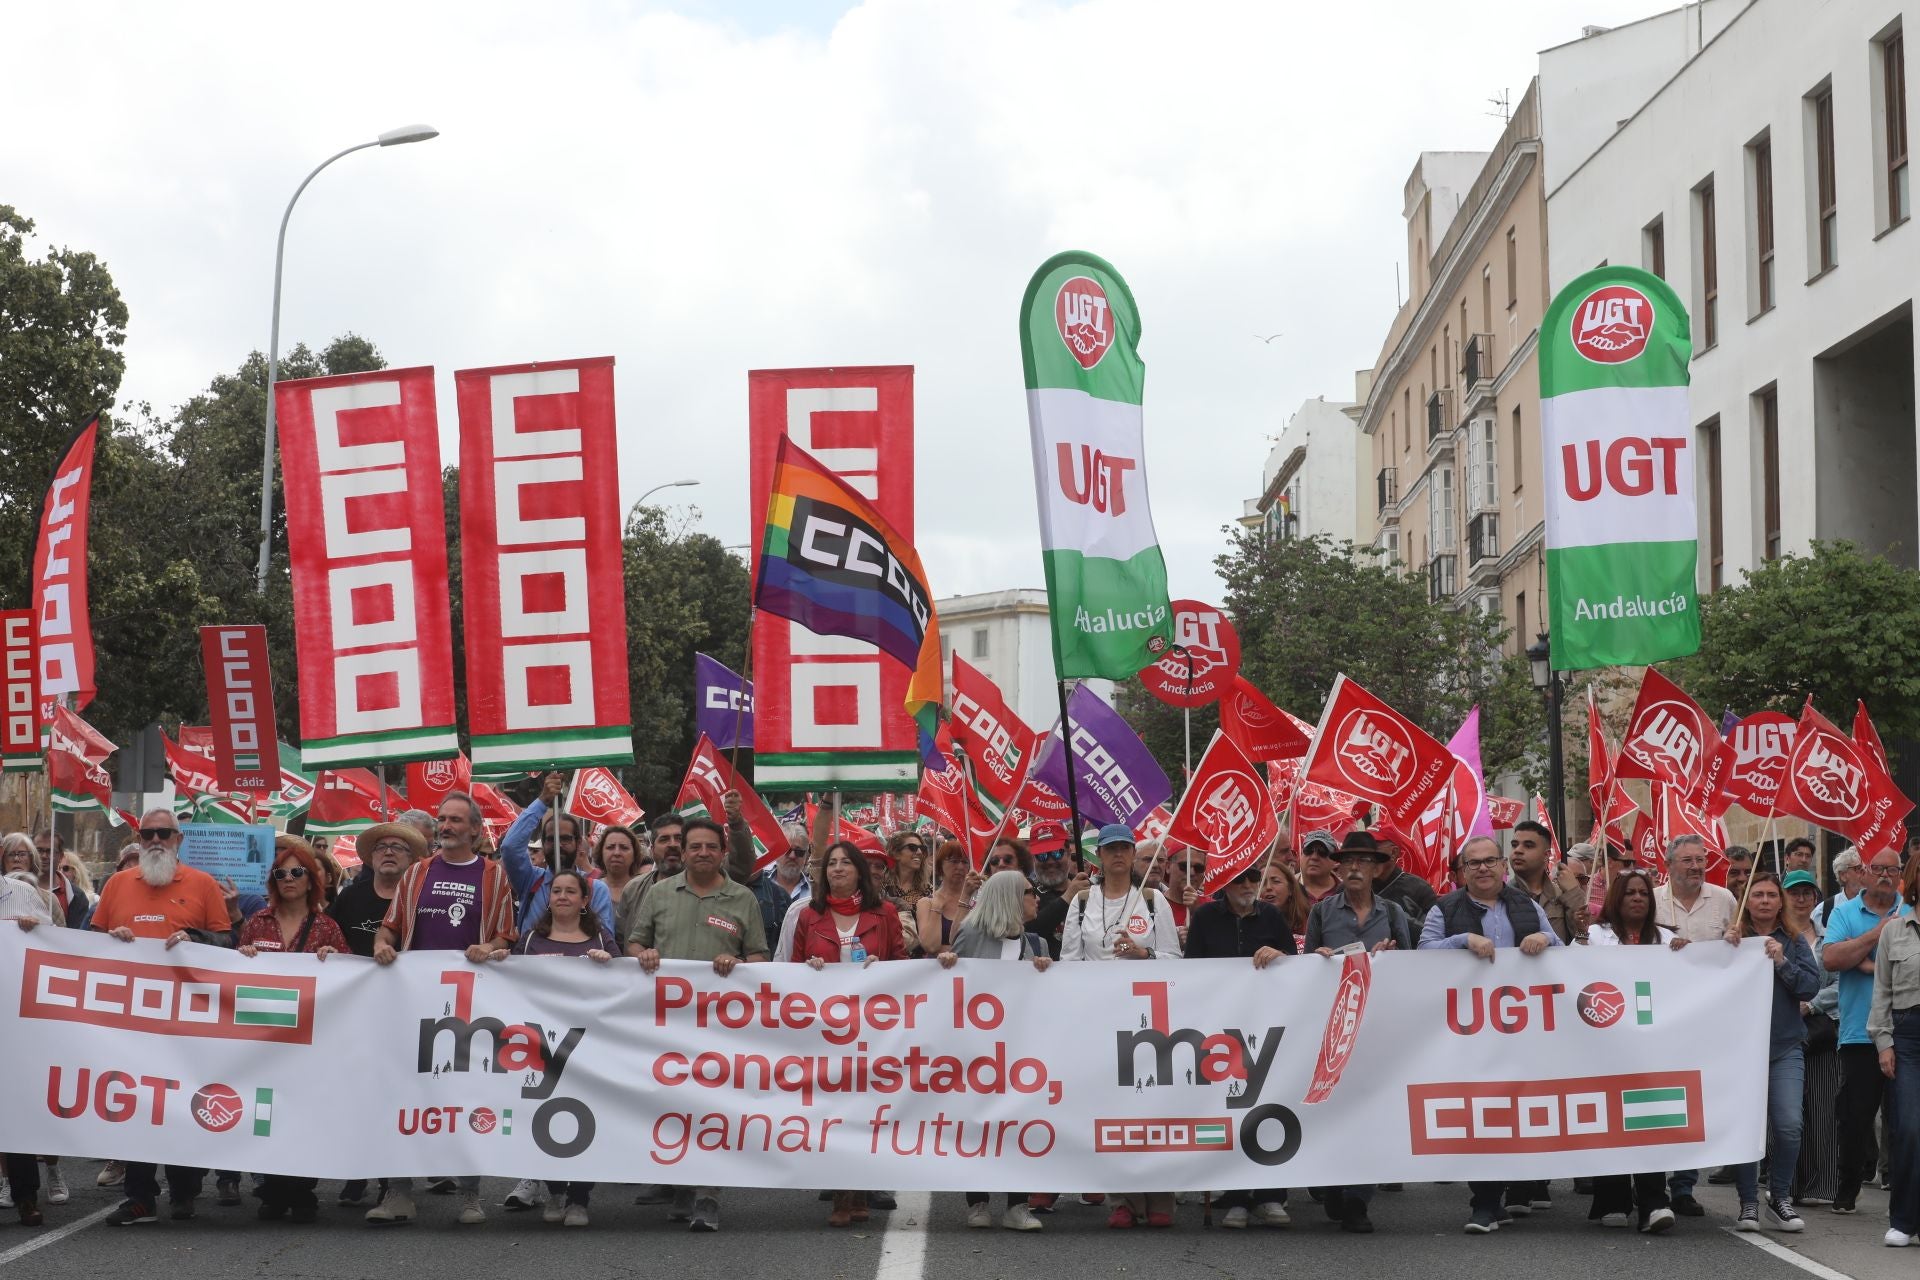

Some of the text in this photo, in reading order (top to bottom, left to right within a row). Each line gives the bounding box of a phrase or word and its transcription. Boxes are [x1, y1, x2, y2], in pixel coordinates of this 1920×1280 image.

[1064, 291, 1107, 325] UGT
[1584, 298, 1643, 329] UGT
[1056, 443, 1136, 518] UGT
[1562, 436, 1687, 501] UGT
[311, 381, 423, 735] CCOO
[490, 369, 595, 730] CCOO
[800, 515, 928, 635] CCOO
[40, 466, 83, 695] CCOO
[1575, 591, 1687, 621] Andalucía
[1174, 611, 1221, 652] GT
[6, 618, 34, 744] CCOO
[220, 631, 259, 750] CCOO
[982, 747, 1012, 785] Cádiz
[1350, 713, 1409, 776] UGT
[1644, 708, 1700, 777] UGT
[1735, 722, 1798, 765] UGT
[235, 776, 265, 787] Cádiz
[1083, 773, 1126, 825] Andalucía
[1209, 777, 1255, 841] UGT
[1396, 758, 1443, 819] www.ugt.es
[1748, 793, 1775, 806] Anda
[182, 829, 207, 837] VERGARA
[208, 830, 226, 838] SOMOS
[1204, 829, 1266, 883] www.ugt.es
[431, 890, 475, 900] enseñanza
[36, 964, 220, 1023] CCOO
[654, 976, 1004, 1045] Proteger lo
[1445, 983, 1565, 1036] UGT
[46, 1066, 180, 1126] UGT
[652, 1041, 1063, 1106] conquistado,
[398, 1107, 463, 1135] UGT
[650, 1104, 1056, 1166] ganar futuro
[1101, 1125, 1189, 1146] CCOO
[1423, 1091, 1608, 1140] CCOO
